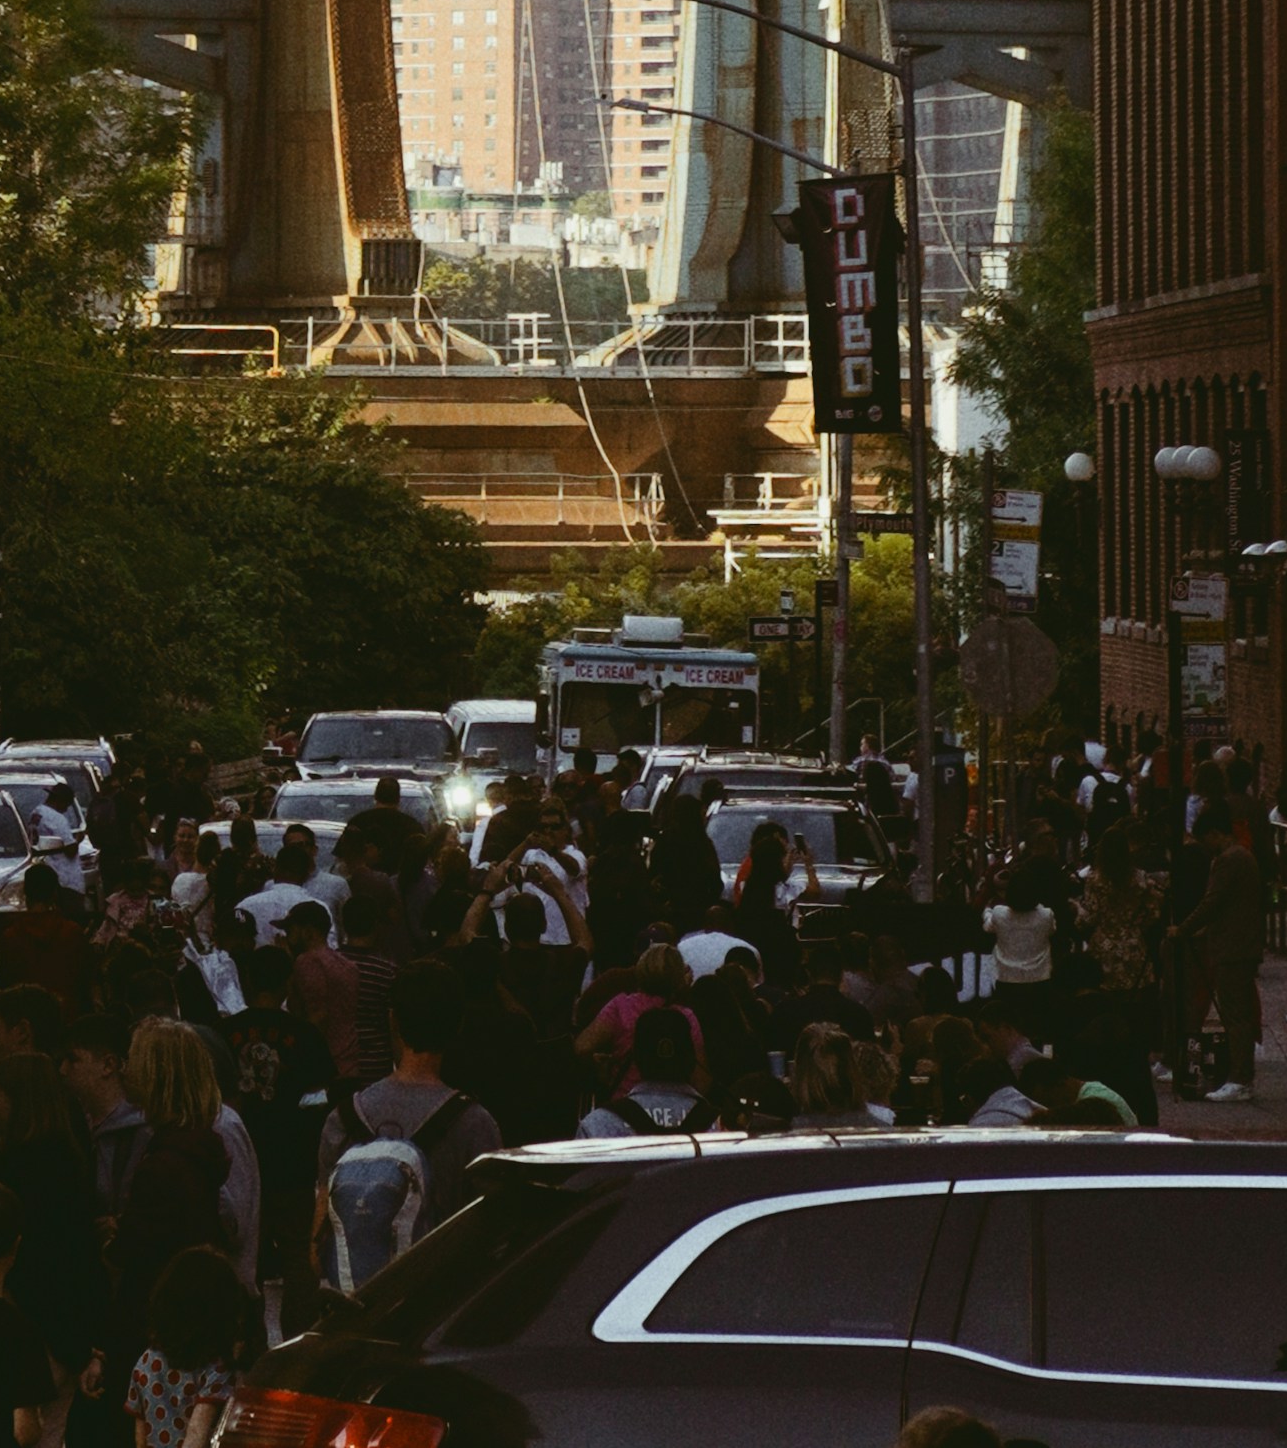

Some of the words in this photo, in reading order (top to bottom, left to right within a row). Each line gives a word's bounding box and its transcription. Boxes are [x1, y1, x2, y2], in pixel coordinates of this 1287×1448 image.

[833, 187, 877, 398] DUMBO
[1228, 440, 1242, 456] 25
[1225, 459, 1242, 536] Washington
[759, 623, 780, 635] ONE
[576, 662, 593, 678] ICE
[596, 663, 635, 680] CREAM
[685, 669, 703, 683] ICE
[706, 670, 744, 684] CREAM
